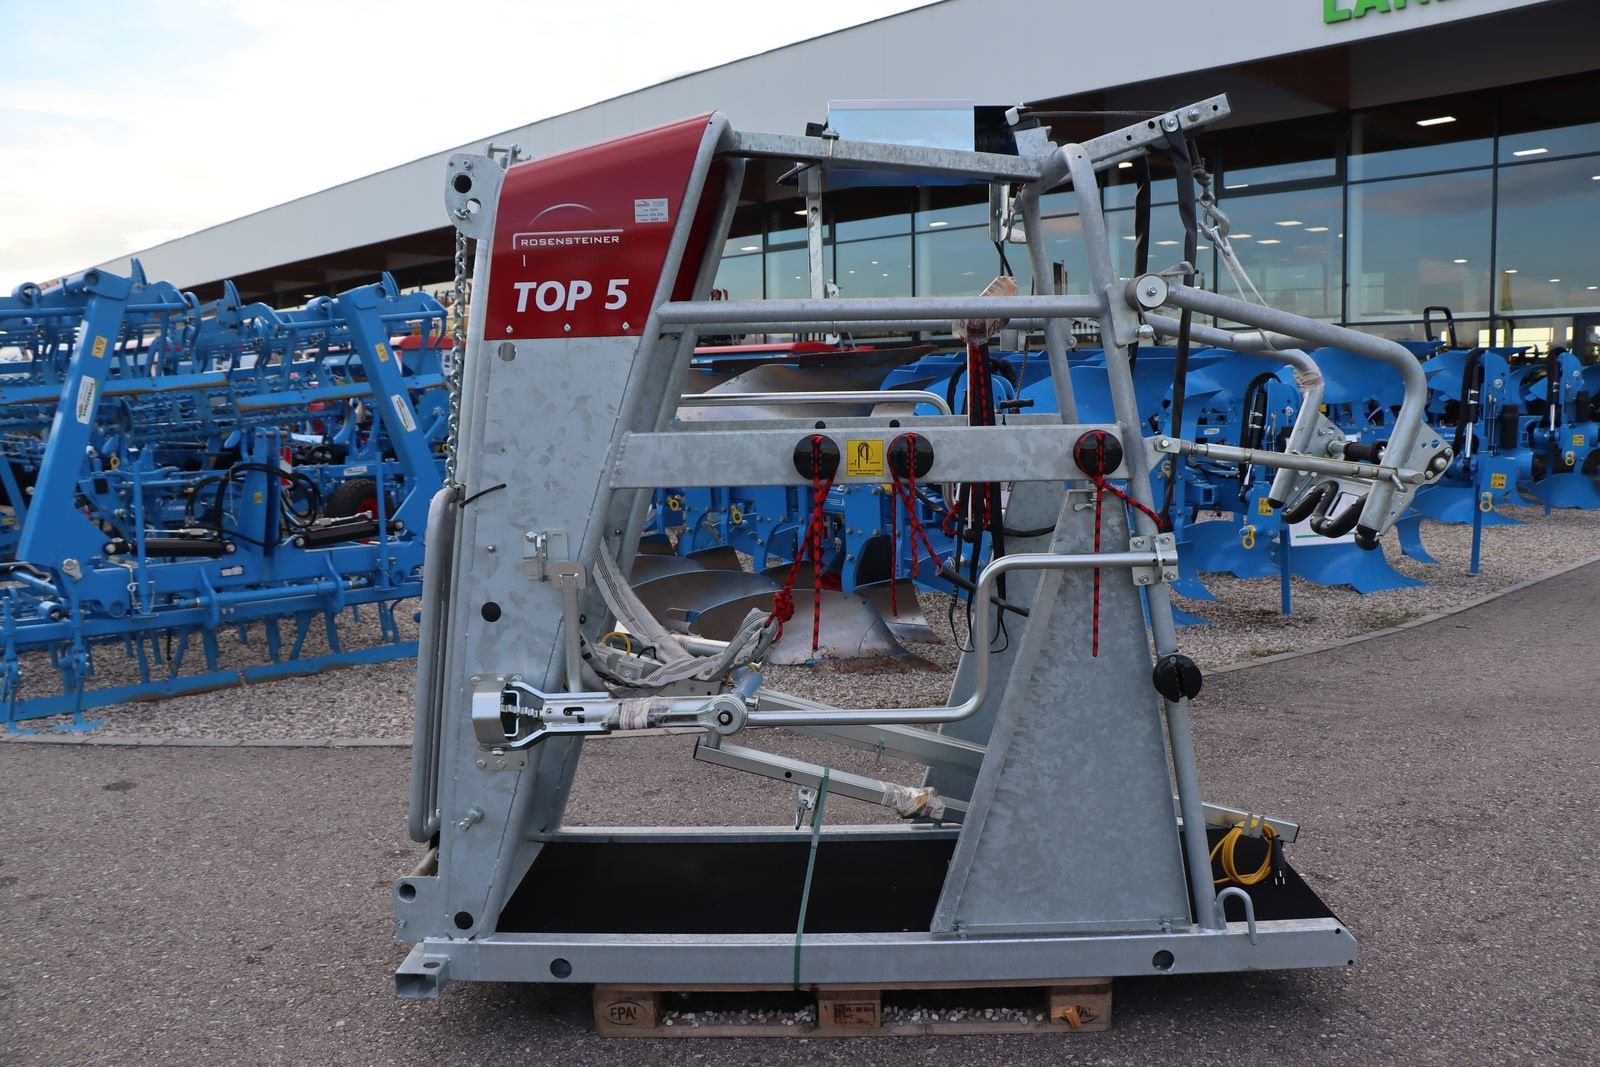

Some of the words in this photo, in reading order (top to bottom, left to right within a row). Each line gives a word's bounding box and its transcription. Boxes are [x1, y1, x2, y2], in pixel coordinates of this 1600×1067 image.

[521, 235, 620, 247] ROSENSTEINER
[513, 280, 593, 313] TOP
[604, 278, 630, 311] 5
